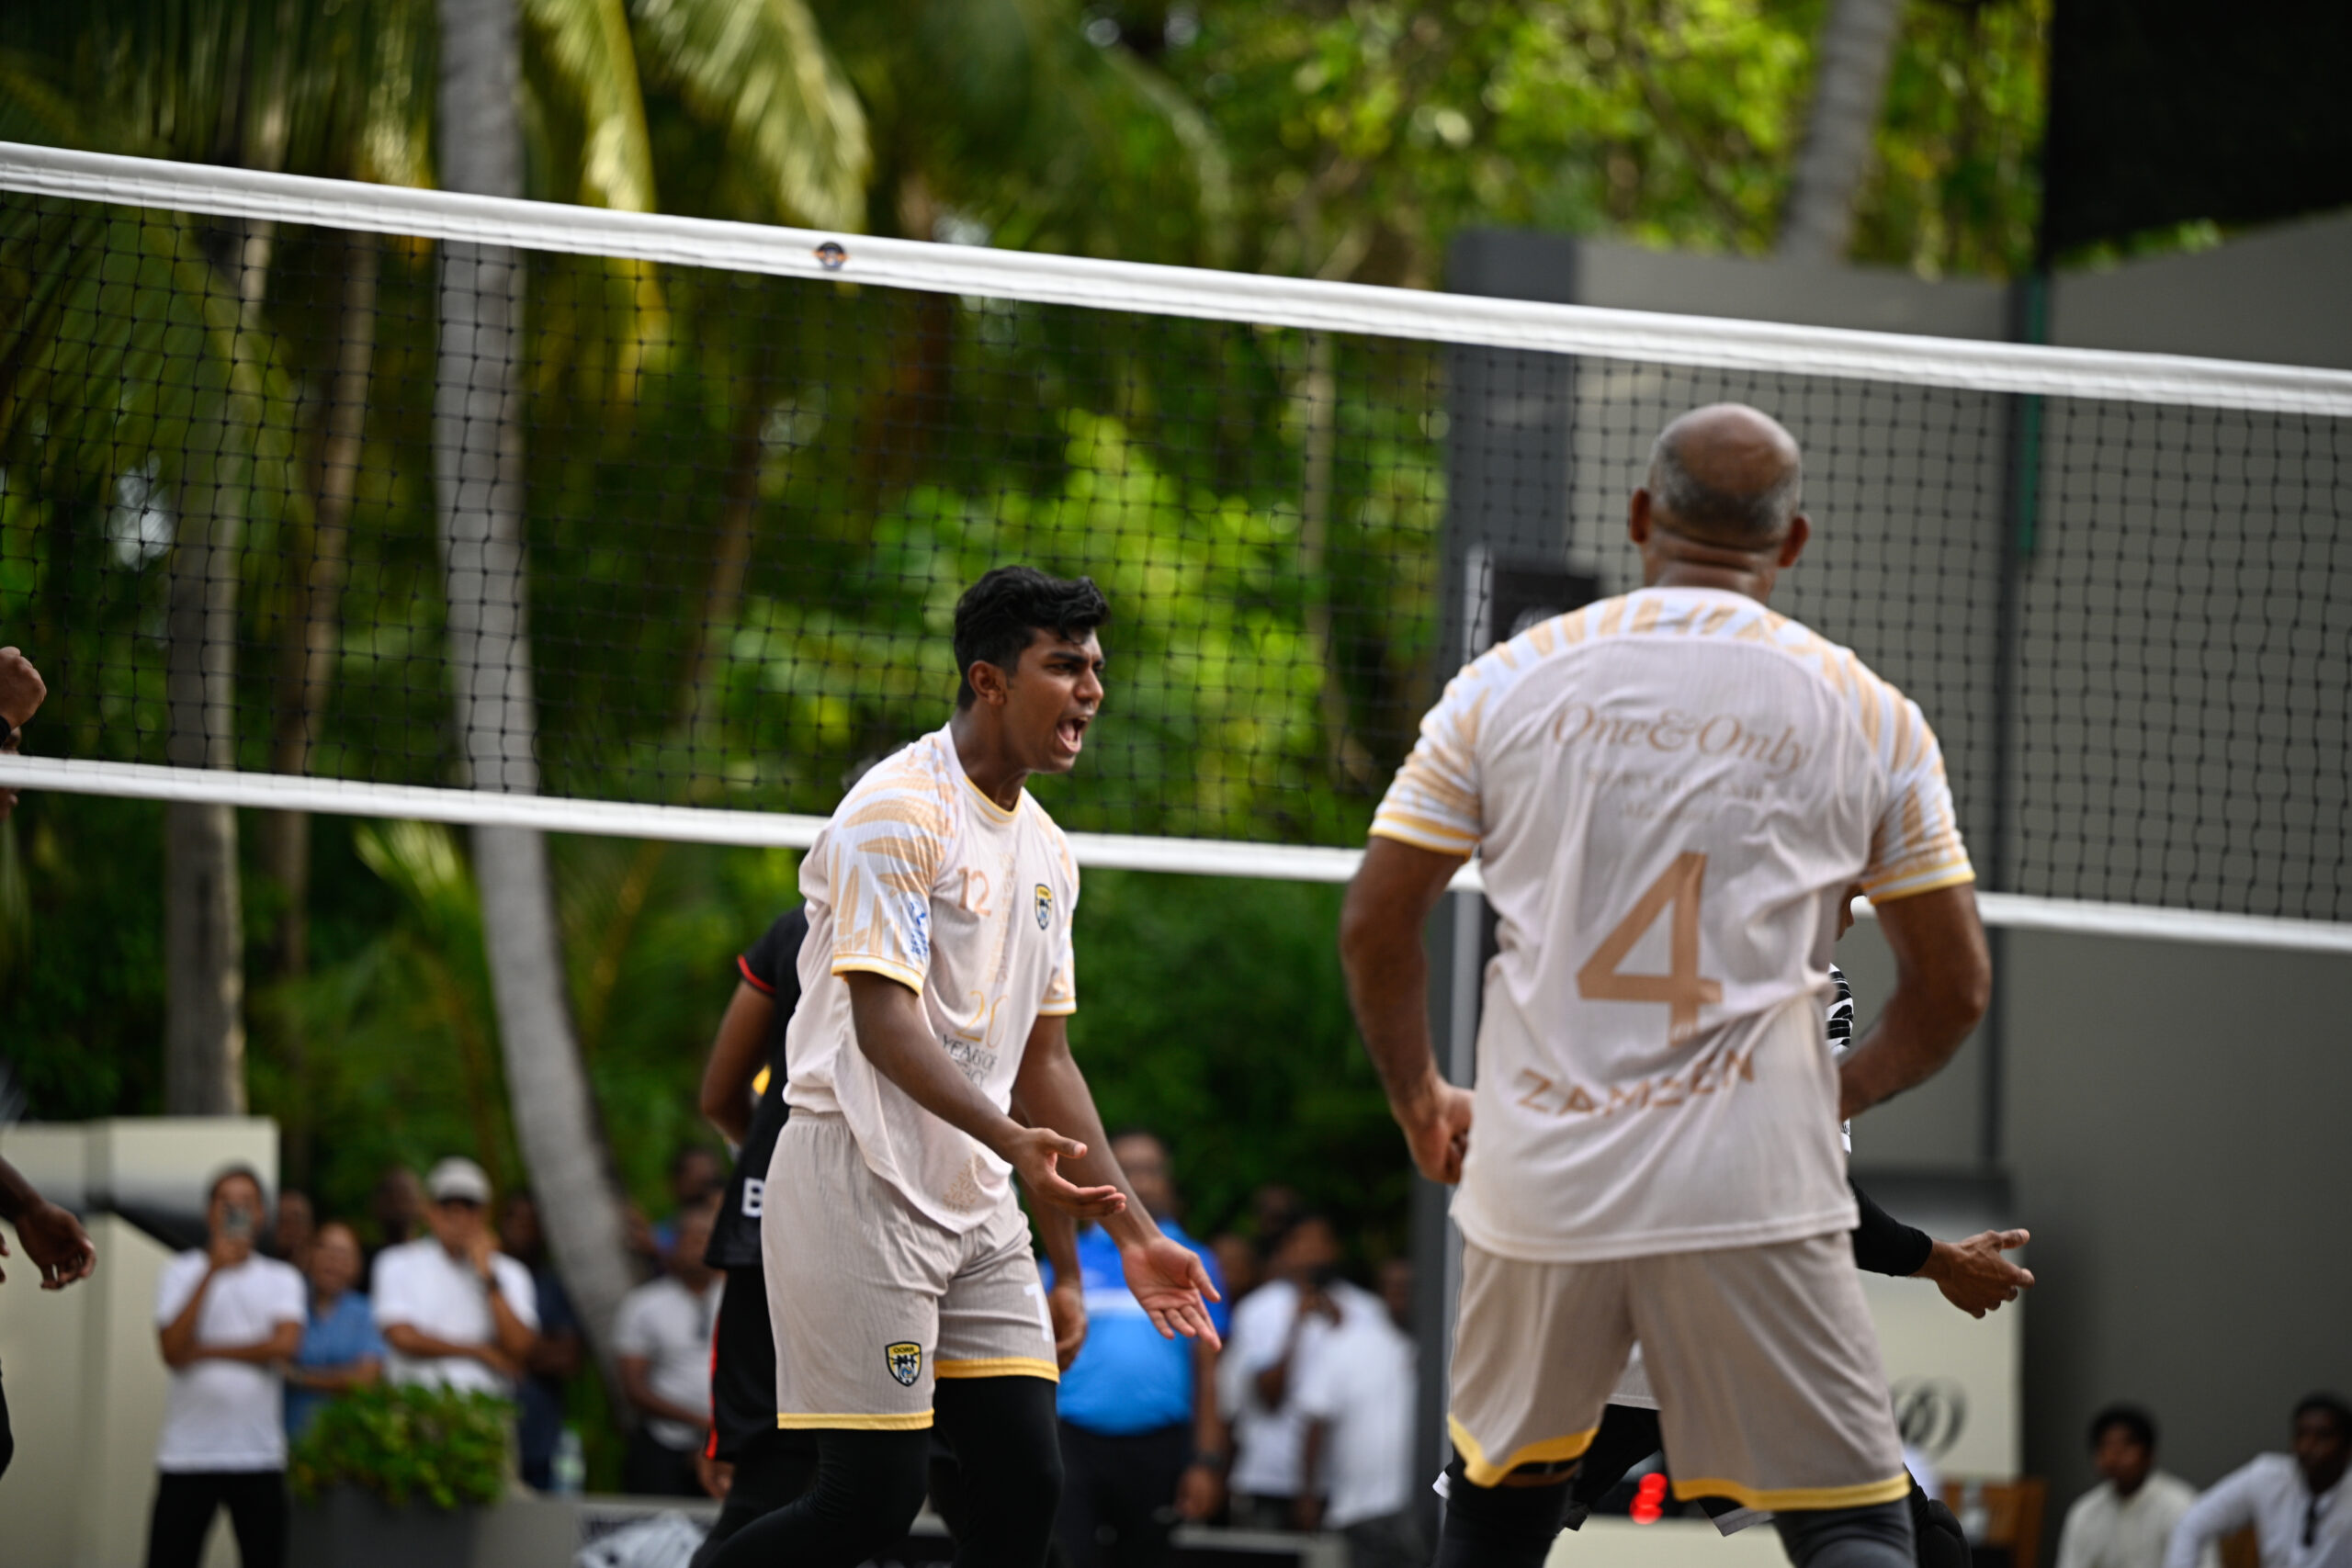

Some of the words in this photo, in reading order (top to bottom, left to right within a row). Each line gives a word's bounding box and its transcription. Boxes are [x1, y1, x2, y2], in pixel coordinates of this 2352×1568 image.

[1553, 702, 1812, 779] One&Only
[957, 866, 991, 918] 12
[1577, 851, 1723, 1047] 4
[955, 990, 1009, 1049] 20
